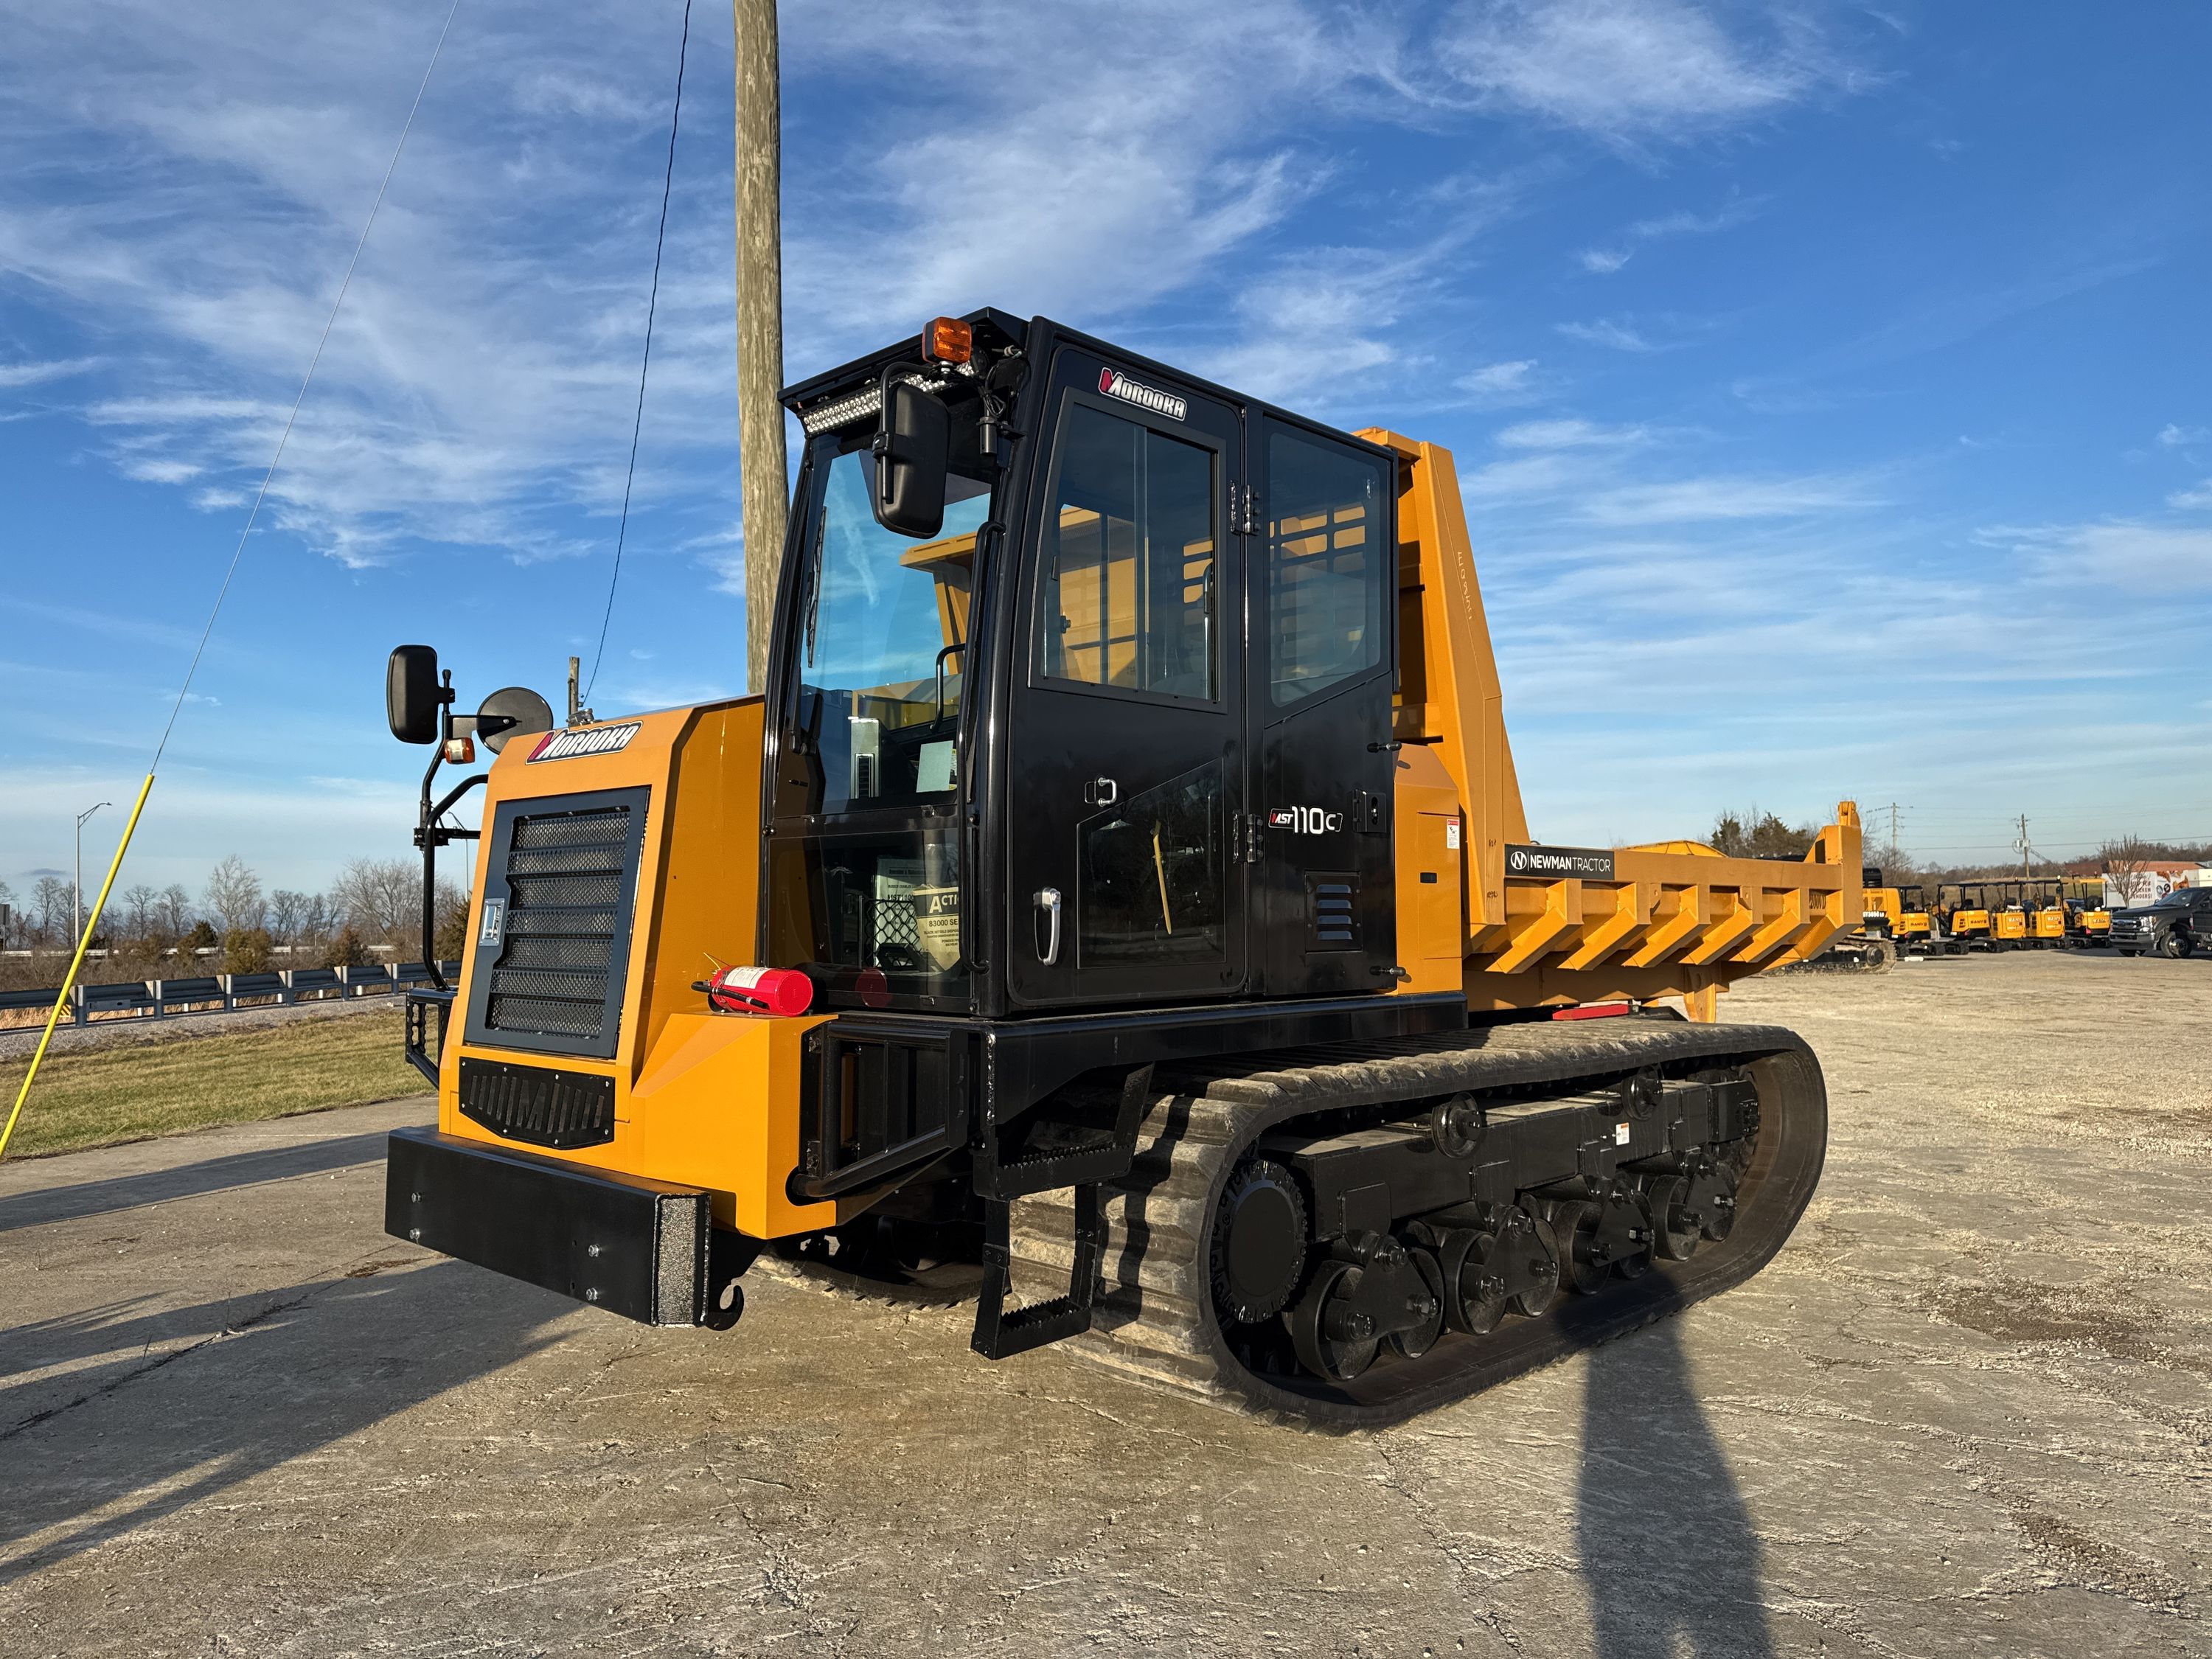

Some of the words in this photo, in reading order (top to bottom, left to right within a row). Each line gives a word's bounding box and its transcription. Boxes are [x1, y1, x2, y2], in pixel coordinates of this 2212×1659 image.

[1100, 370, 1185, 418] MOROOKA
[527, 724, 640, 762] MOROOKA
[929, 894, 959, 914] ACTI
[928, 919, 948, 927] 83000
